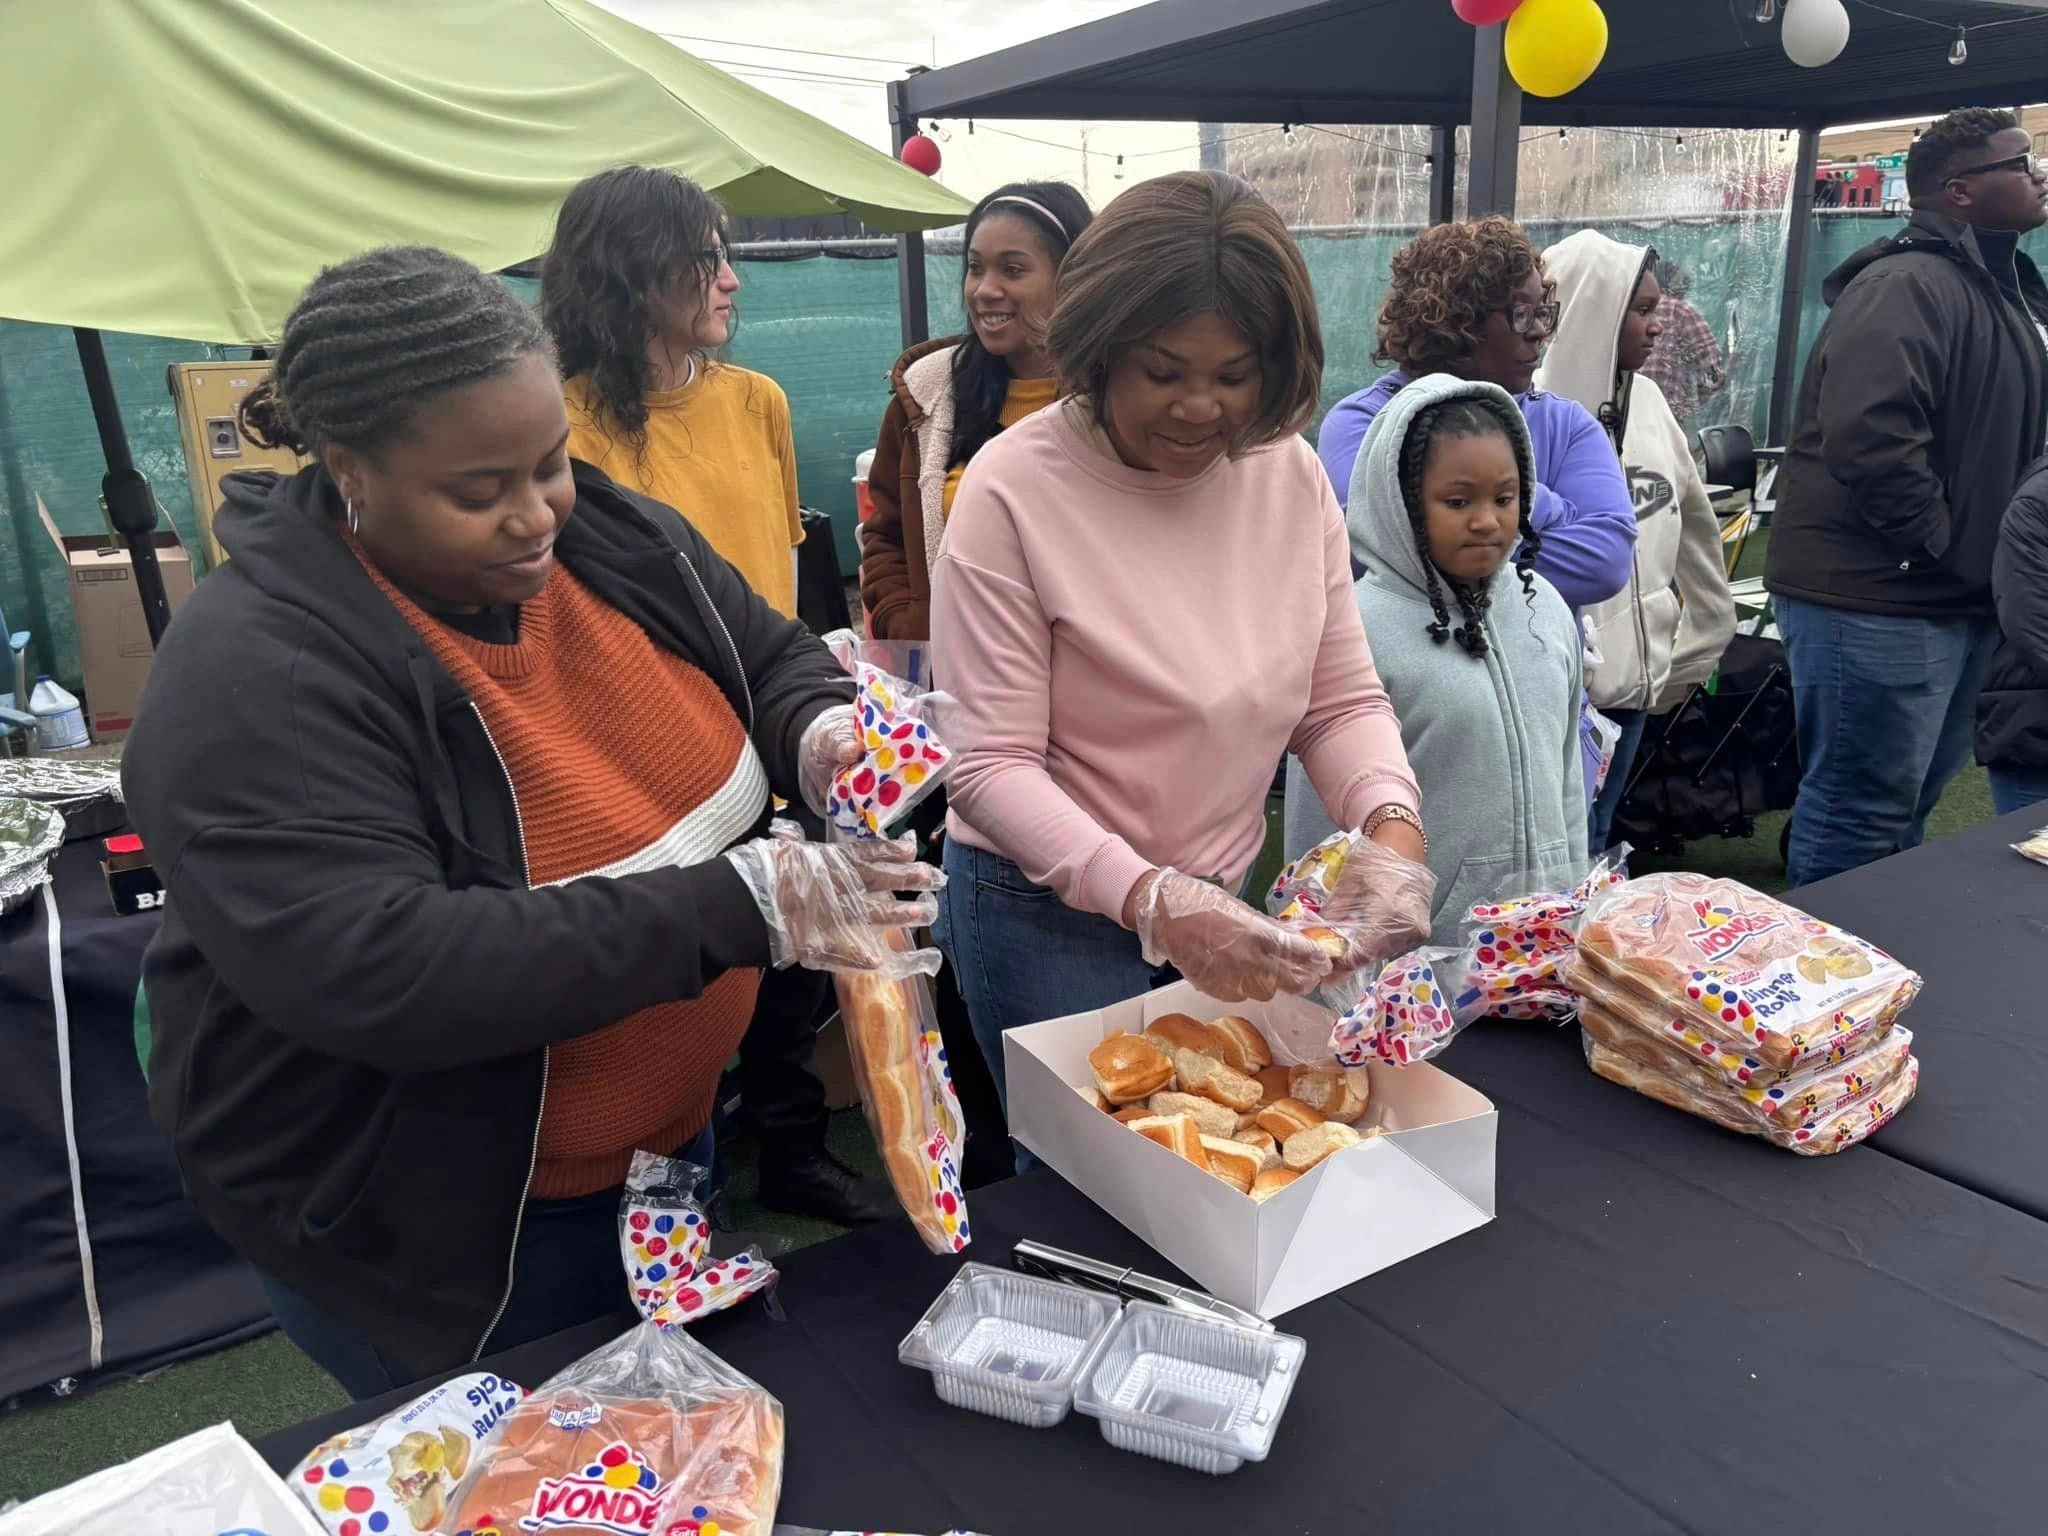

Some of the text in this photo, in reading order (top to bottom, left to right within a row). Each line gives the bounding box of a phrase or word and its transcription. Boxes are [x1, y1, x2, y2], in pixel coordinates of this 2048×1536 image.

[1692, 915, 1776, 956] WONDER
[1742, 972, 1797, 1003] Dinner
[1755, 989, 1801, 1018] Rolls
[1805, 1094, 1817, 1105] 12
[536, 1485, 662, 1529] WONDE
